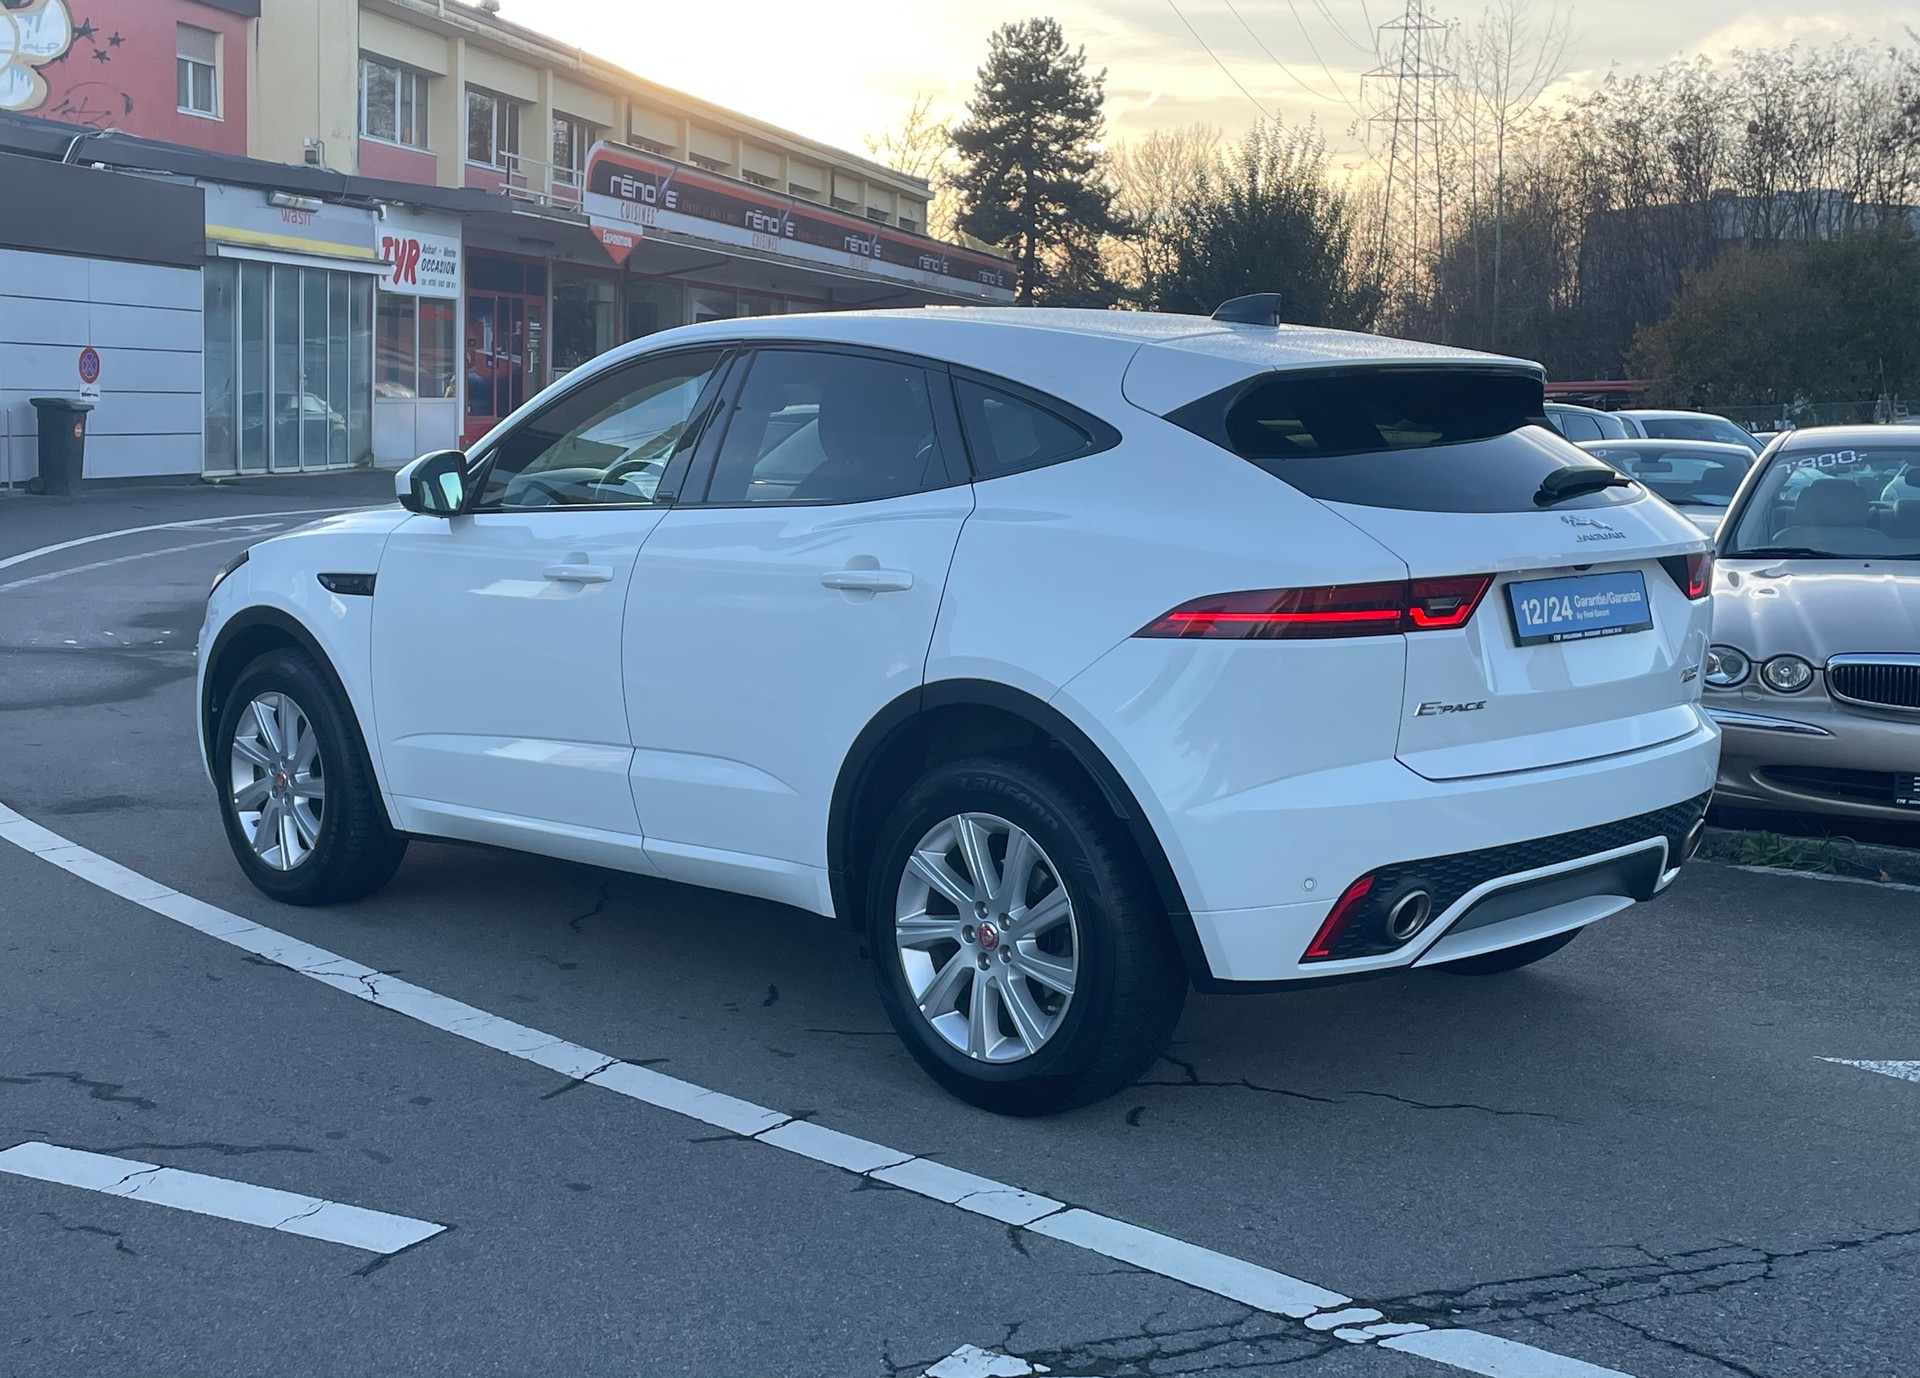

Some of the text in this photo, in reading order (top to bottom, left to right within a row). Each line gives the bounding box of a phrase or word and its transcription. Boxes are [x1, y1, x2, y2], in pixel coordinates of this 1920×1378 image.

[620, 202, 655, 225] CUISINES
[382, 236, 420, 285] TYR
[421, 258, 456, 275] OCCASION
[1521, 589, 1641, 625] 12/24 Garantie/Garanzia
